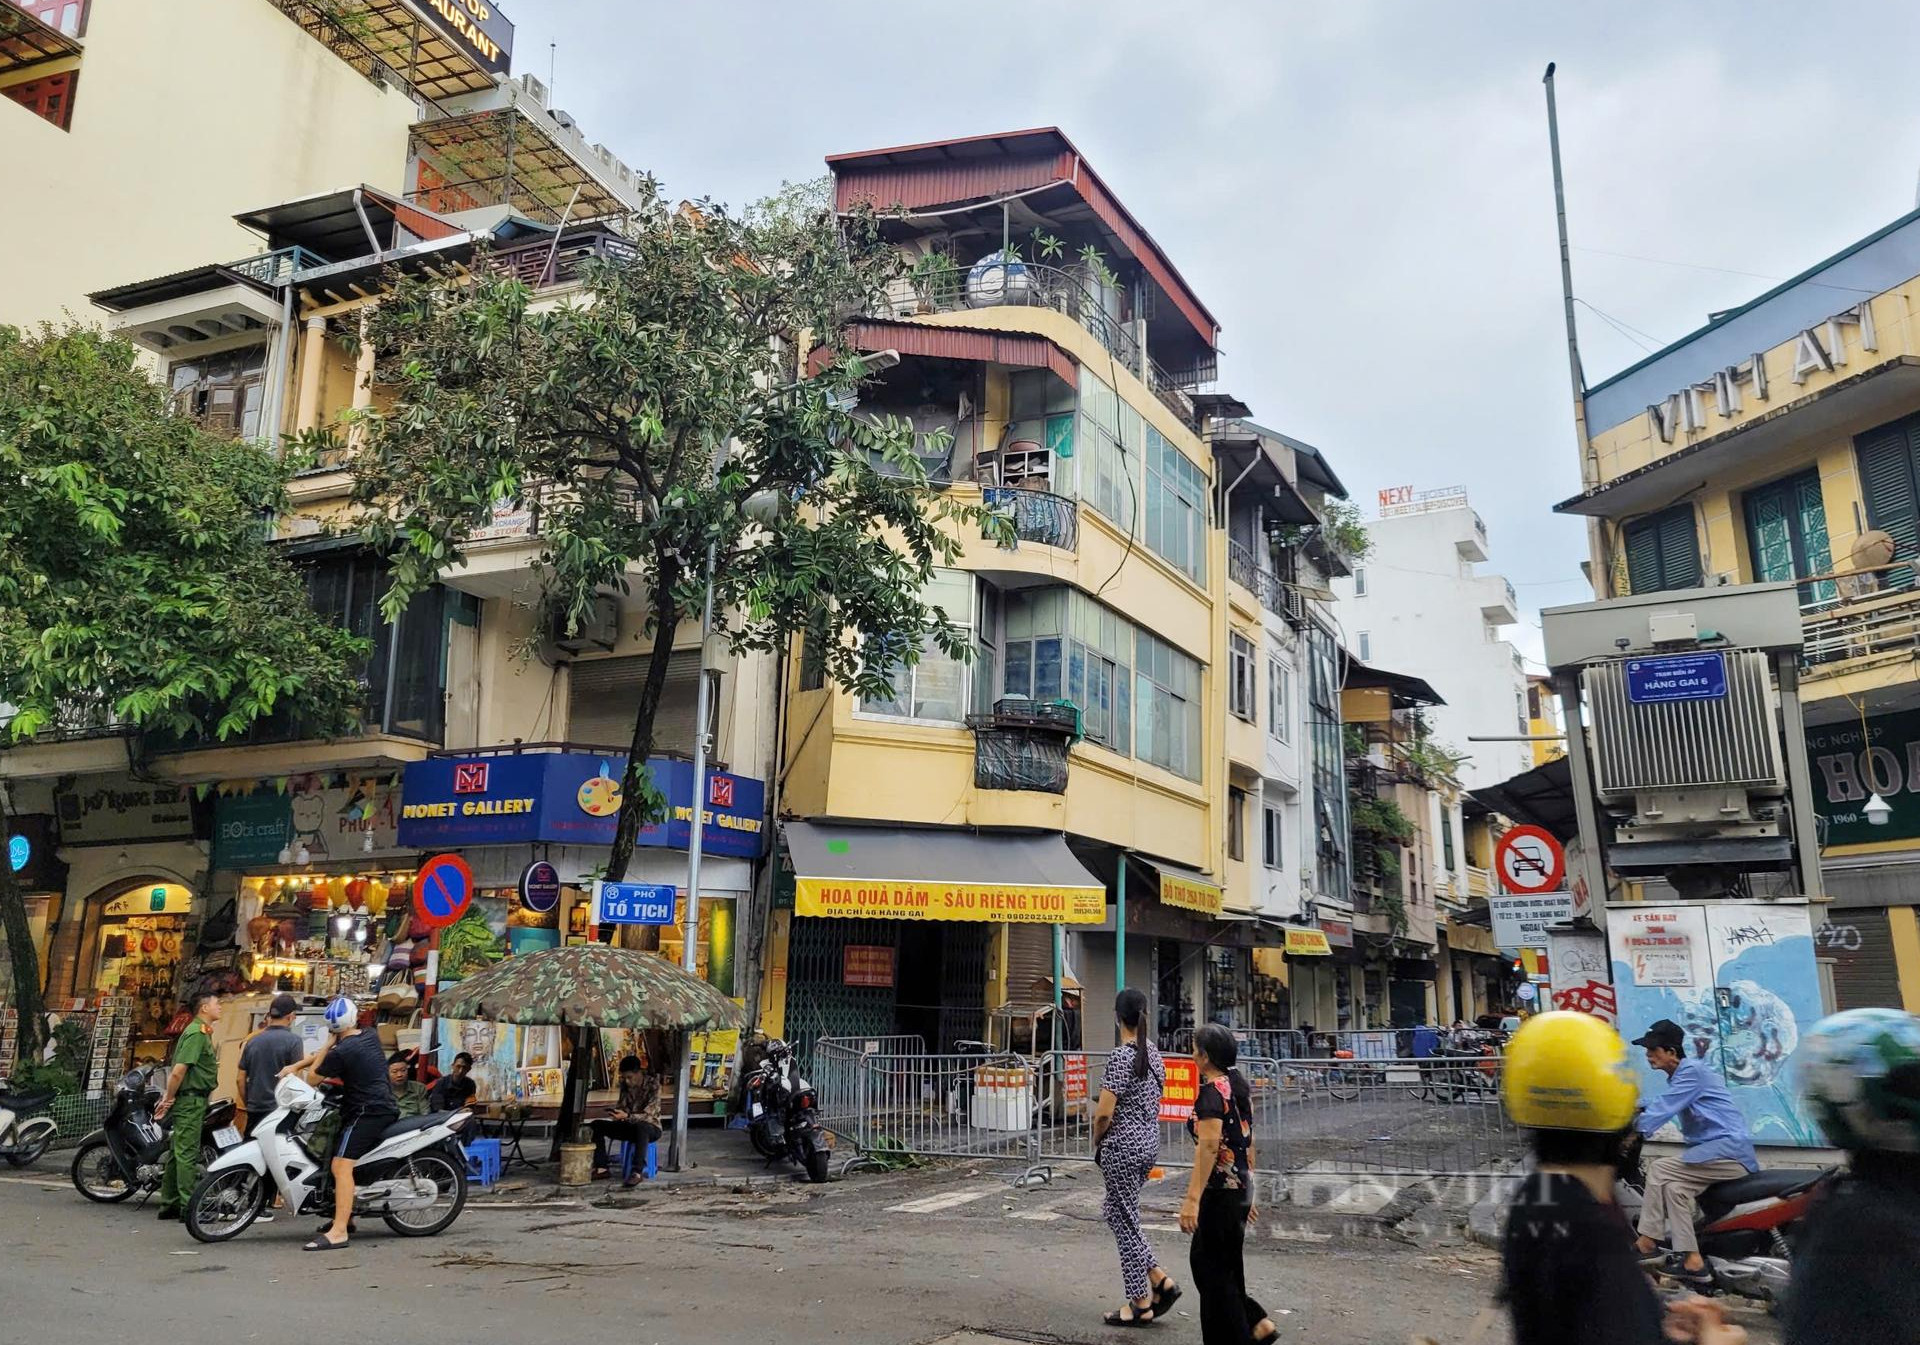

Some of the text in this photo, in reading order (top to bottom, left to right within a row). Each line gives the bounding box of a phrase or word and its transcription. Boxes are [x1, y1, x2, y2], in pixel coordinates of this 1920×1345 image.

[1378, 485, 1413, 505] NEXY
[1645, 679, 1677, 690] HÀNG
[1679, 678, 1699, 687] GAI
[403, 798, 535, 819] MONET GALLERY
[675, 805, 763, 833] MOET GALLERY
[1832, 812, 1857, 824] 1960
[257, 819, 286, 836] craft
[633, 888, 656, 898] PHỐ
[820, 888, 854, 904] HOA
[857, 885, 890, 906] QUẢ
[894, 885, 929, 907] DẦM
[944, 888, 975, 909] SẦU
[980, 890, 1027, 910] RIÊNG
[1032, 894, 1065, 911] TƯƠI
[608, 899, 668, 920] TỐ TỊCH
[1520, 923, 1541, 934] NGOẠI
[1523, 934, 1547, 942] Excep
